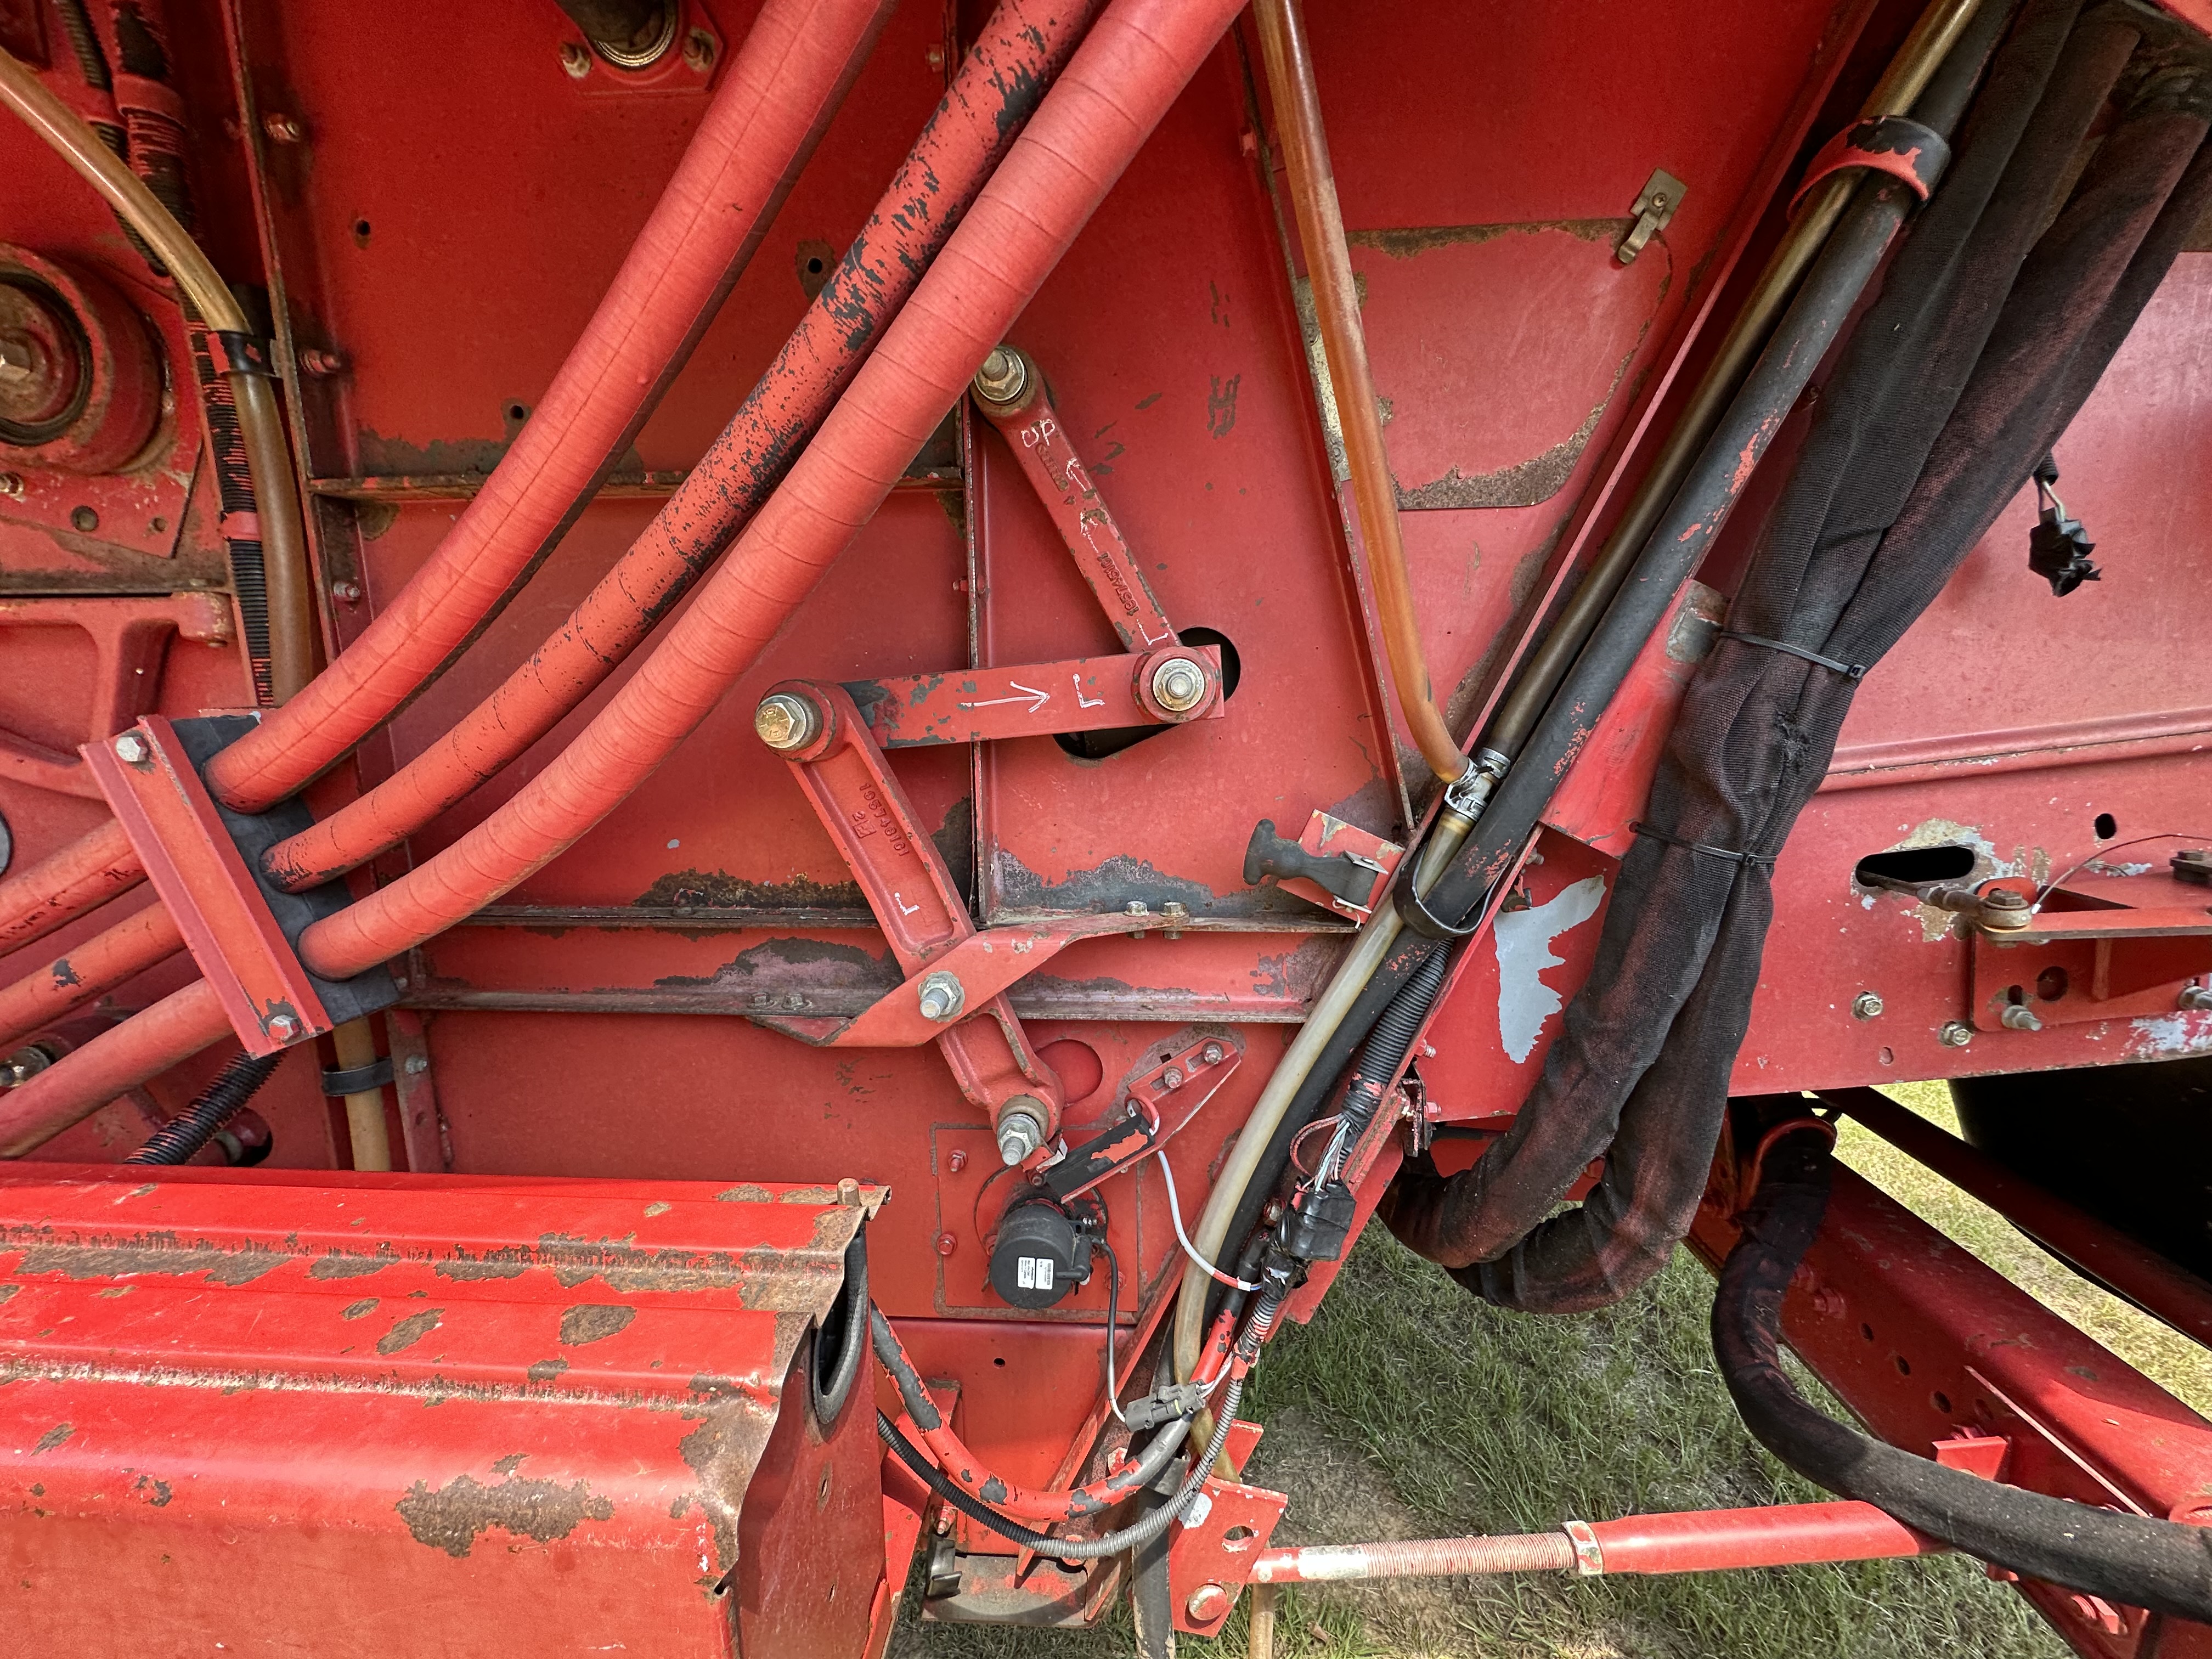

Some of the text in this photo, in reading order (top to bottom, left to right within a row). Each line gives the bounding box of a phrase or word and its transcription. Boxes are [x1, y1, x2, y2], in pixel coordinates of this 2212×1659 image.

[1021, 419, 1056, 448] UP
[1136, 619, 1169, 646] L
[1073, 673, 1105, 708] L
[894, 892, 919, 916] L
